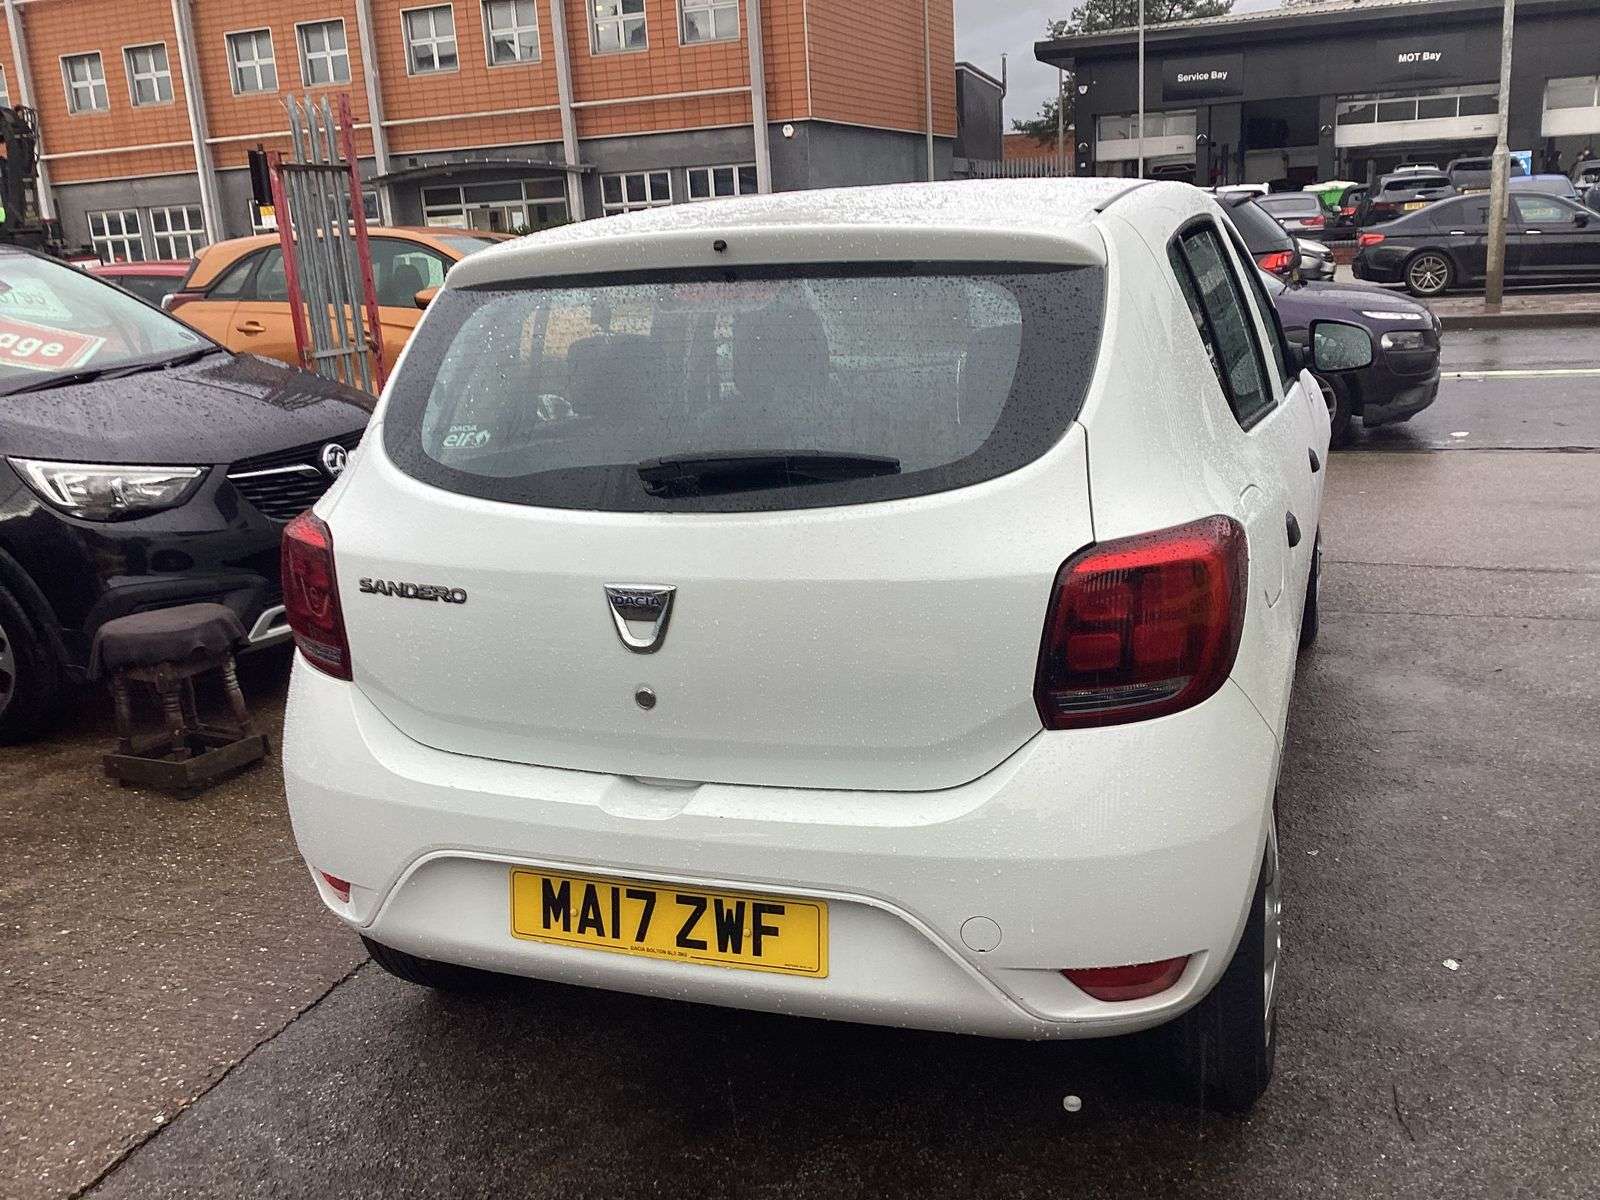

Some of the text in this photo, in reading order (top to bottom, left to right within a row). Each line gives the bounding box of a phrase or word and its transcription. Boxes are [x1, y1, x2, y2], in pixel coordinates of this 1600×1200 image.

[1398, 51, 1442, 63] MOT Bay
[1177, 70, 1228, 82] Service Bay
[442, 432, 475, 447] elf
[359, 577, 467, 604] SANDERO
[613, 596, 662, 606] DACIA
[541, 877, 786, 957] MA17 ZWF
